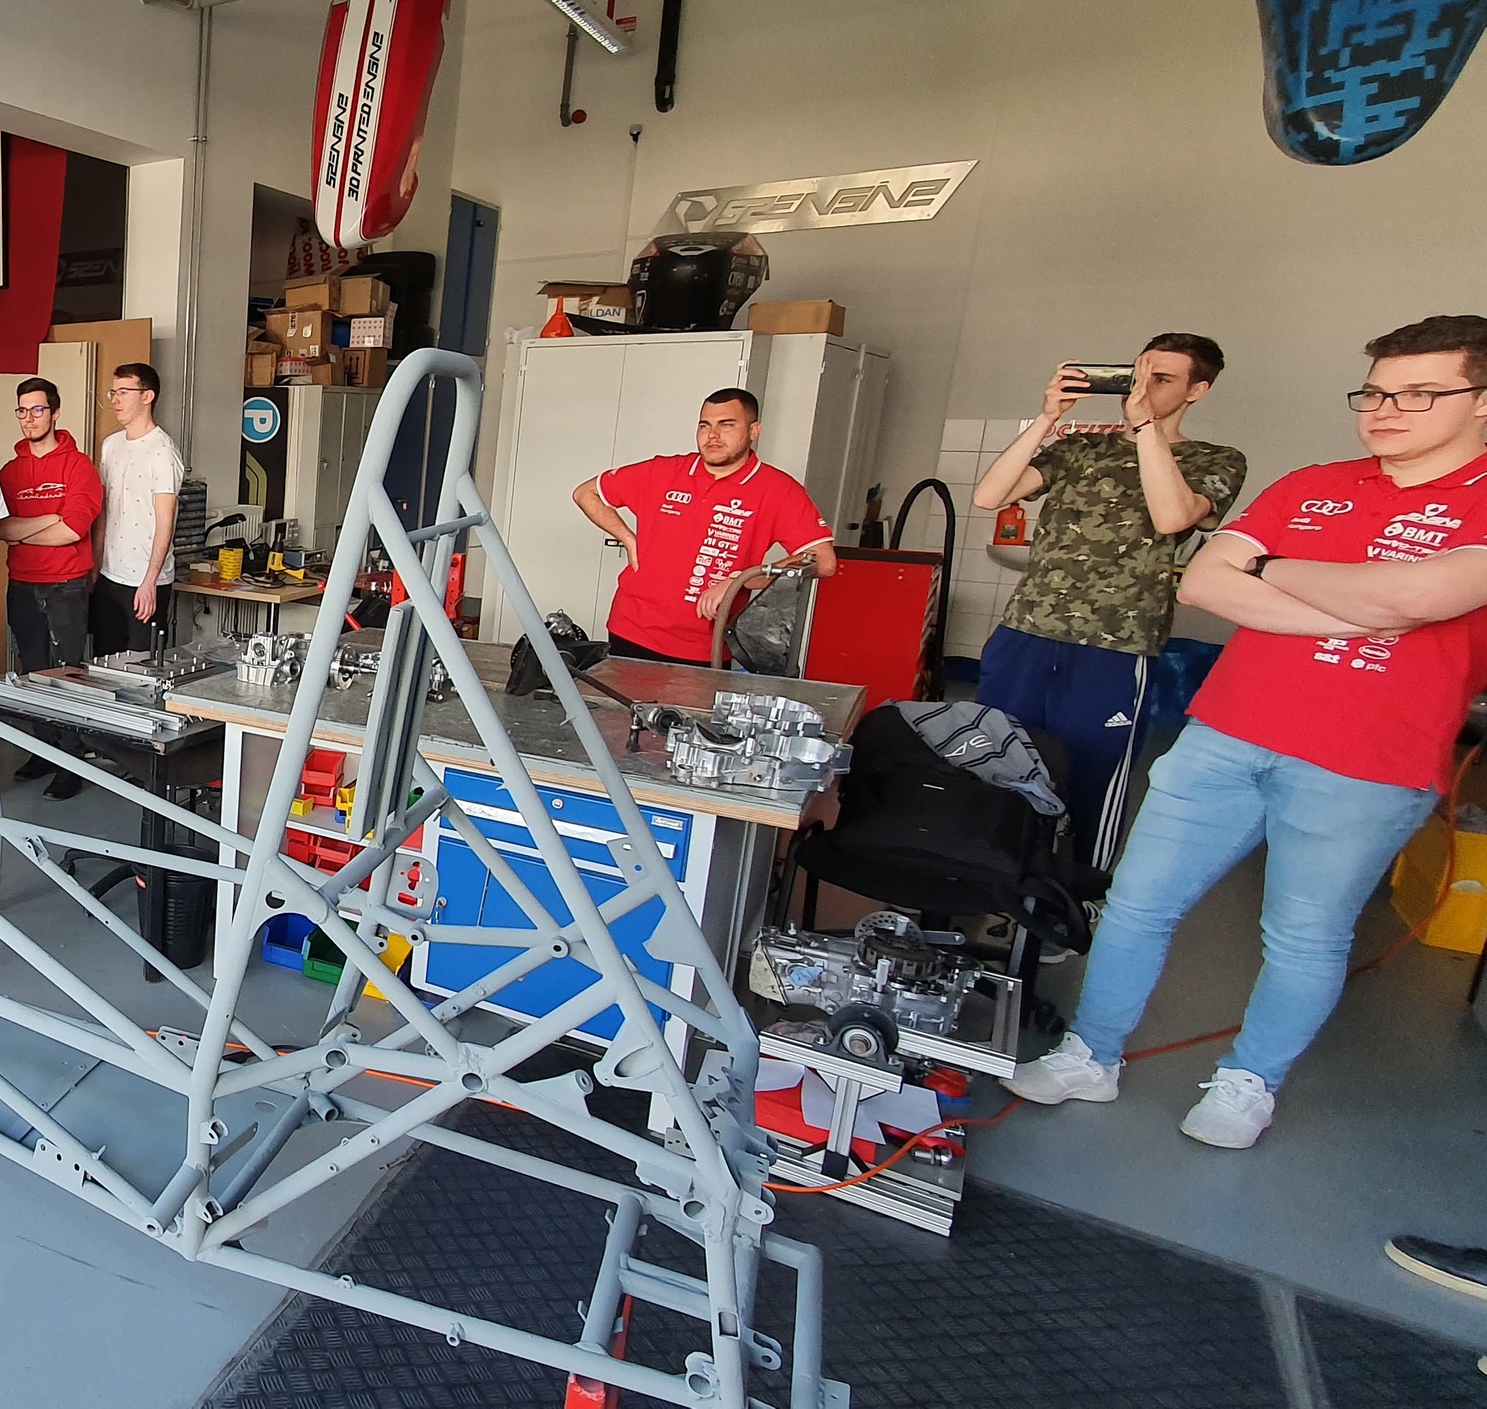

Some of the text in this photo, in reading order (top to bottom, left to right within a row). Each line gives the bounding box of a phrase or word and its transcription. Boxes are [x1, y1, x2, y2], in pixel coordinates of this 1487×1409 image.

[347, 177, 361, 202] 3D
[589, 308, 621, 318] LDAN
[1401, 526, 1449, 545] BMT
